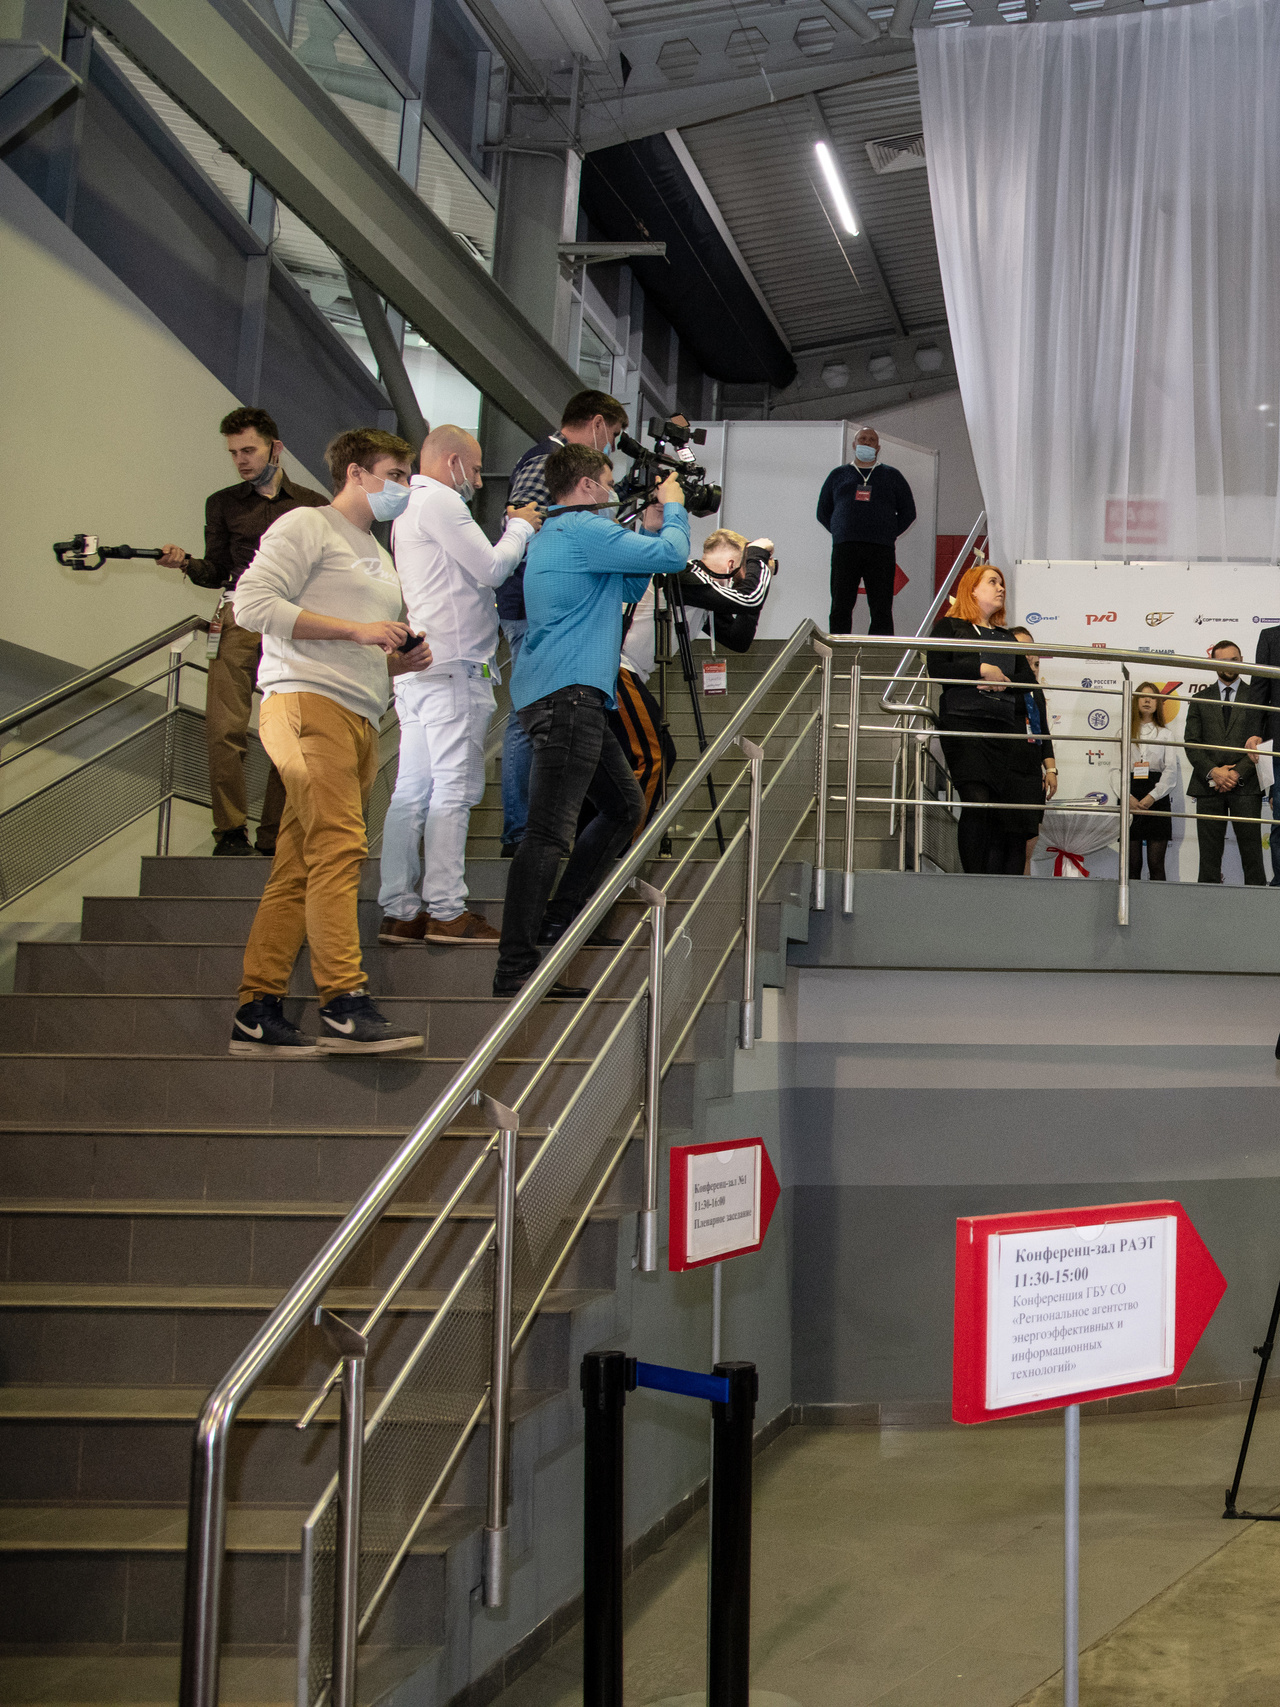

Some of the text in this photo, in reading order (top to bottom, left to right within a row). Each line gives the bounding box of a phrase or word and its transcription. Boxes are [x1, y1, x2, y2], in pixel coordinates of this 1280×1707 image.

[694, 1209, 752, 1229] Пленарное заседание
[1015, 1235, 1156, 1263] Конференц-зал РАЭТ
[1014, 1267, 1089, 1288] 11:30-15:00
[1013, 1283, 1127, 1308] Конференция ГБУ СО
[1012, 1299, 1139, 1326] «Региональное агентство
[1012, 1320, 1124, 1344] энергоэффективных и
[1011, 1340, 1103, 1363] информационных
[1011, 1363, 1077, 1381] технологий»
